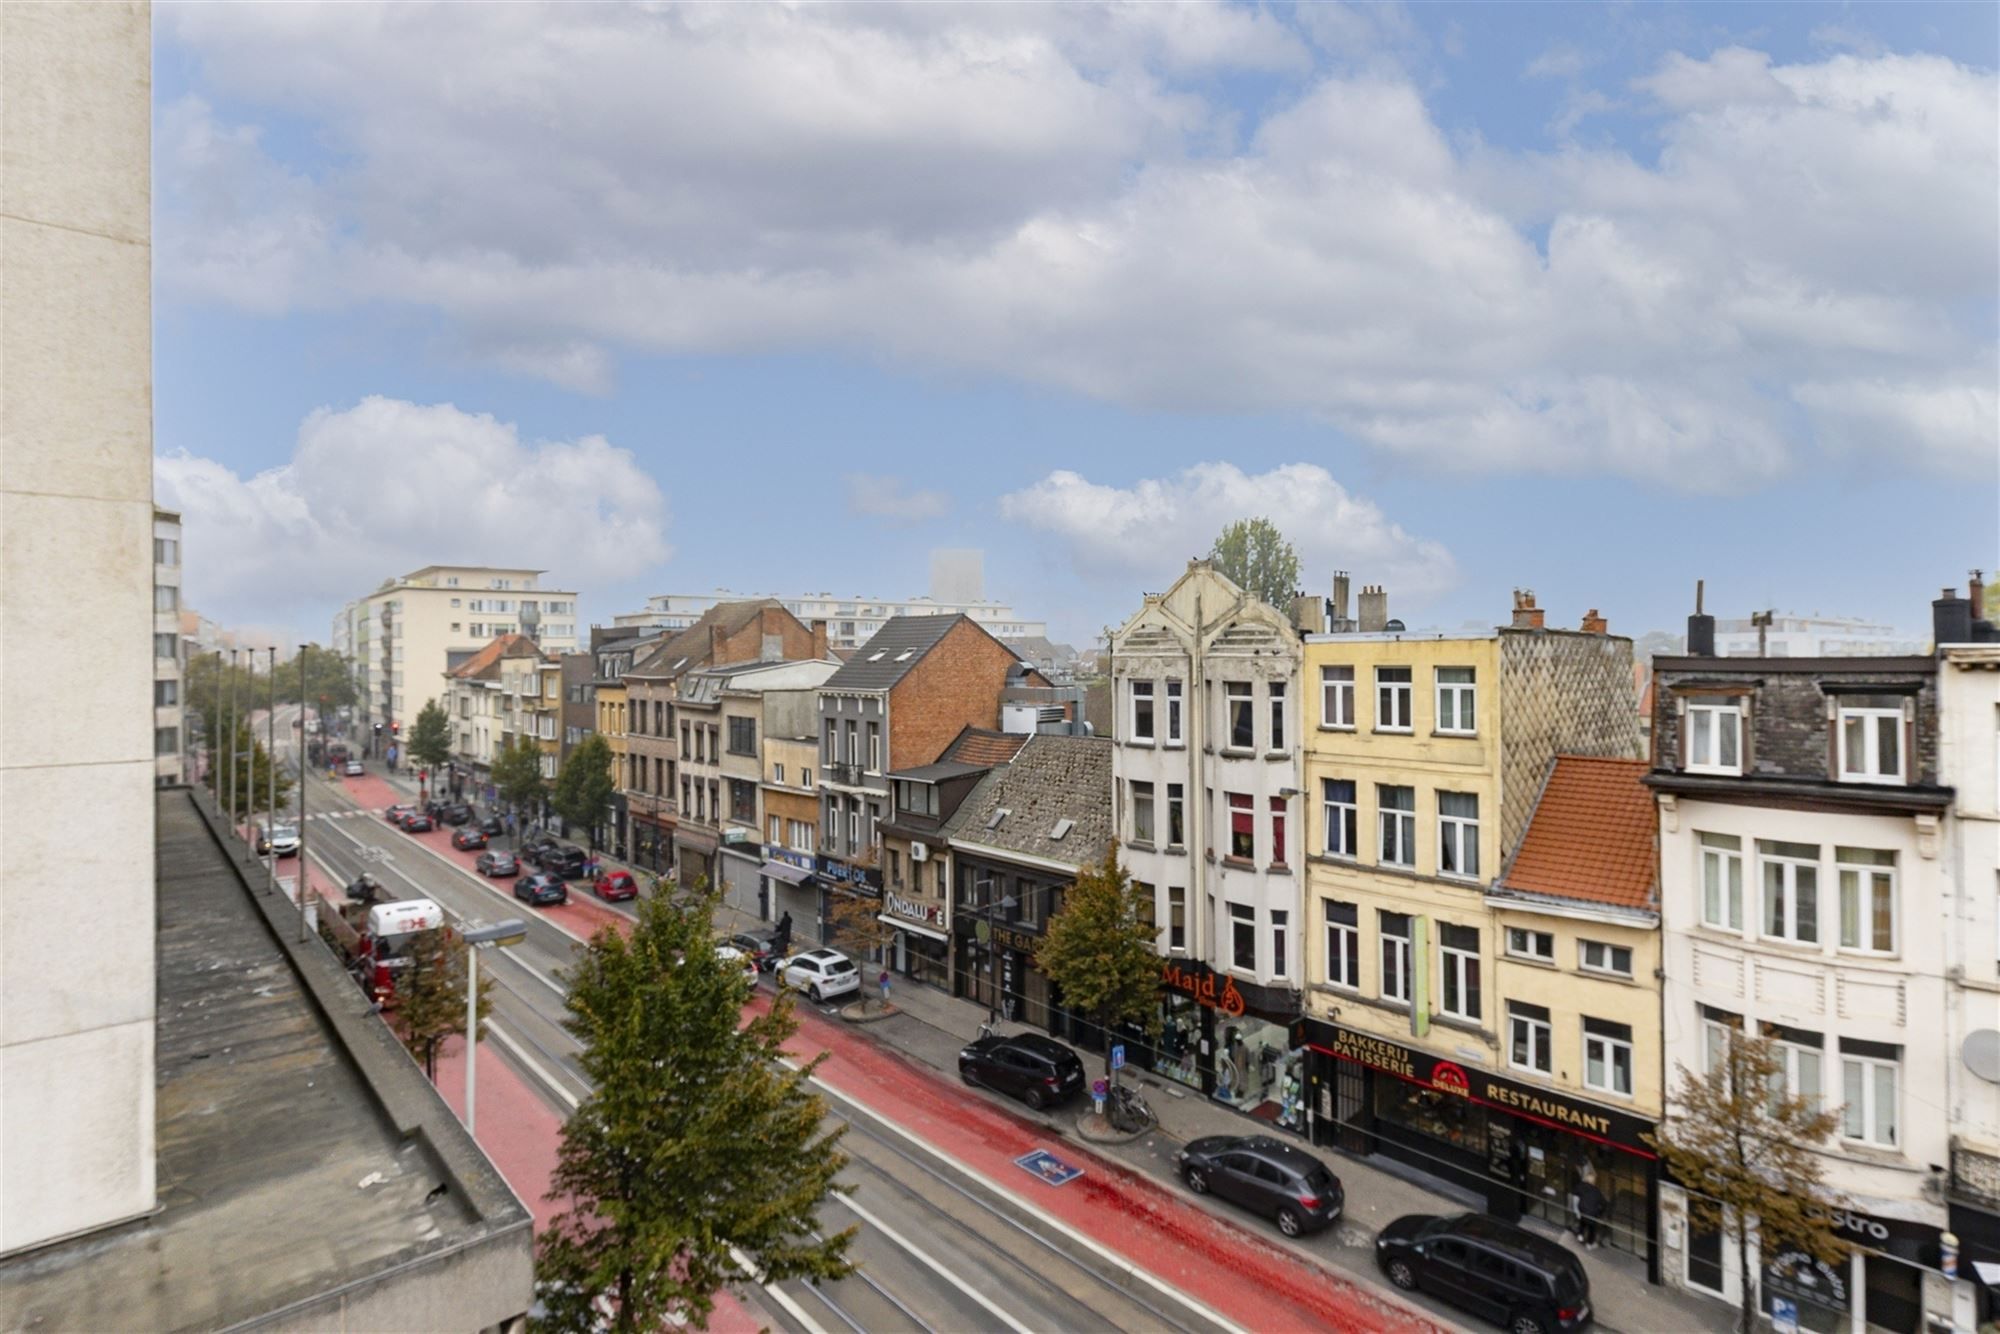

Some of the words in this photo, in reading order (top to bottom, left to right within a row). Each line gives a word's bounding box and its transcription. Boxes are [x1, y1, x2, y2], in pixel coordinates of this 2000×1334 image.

[993, 928, 1012, 945] THE
[1161, 965, 1216, 999] Majd
[1333, 1041, 1415, 1078] PATISSERIE
[1338, 1030, 1409, 1062] BAKKERIJ
[1432, 1078, 1469, 1097] DELUXE
[1487, 1083, 1611, 1134] RESTAURANT
